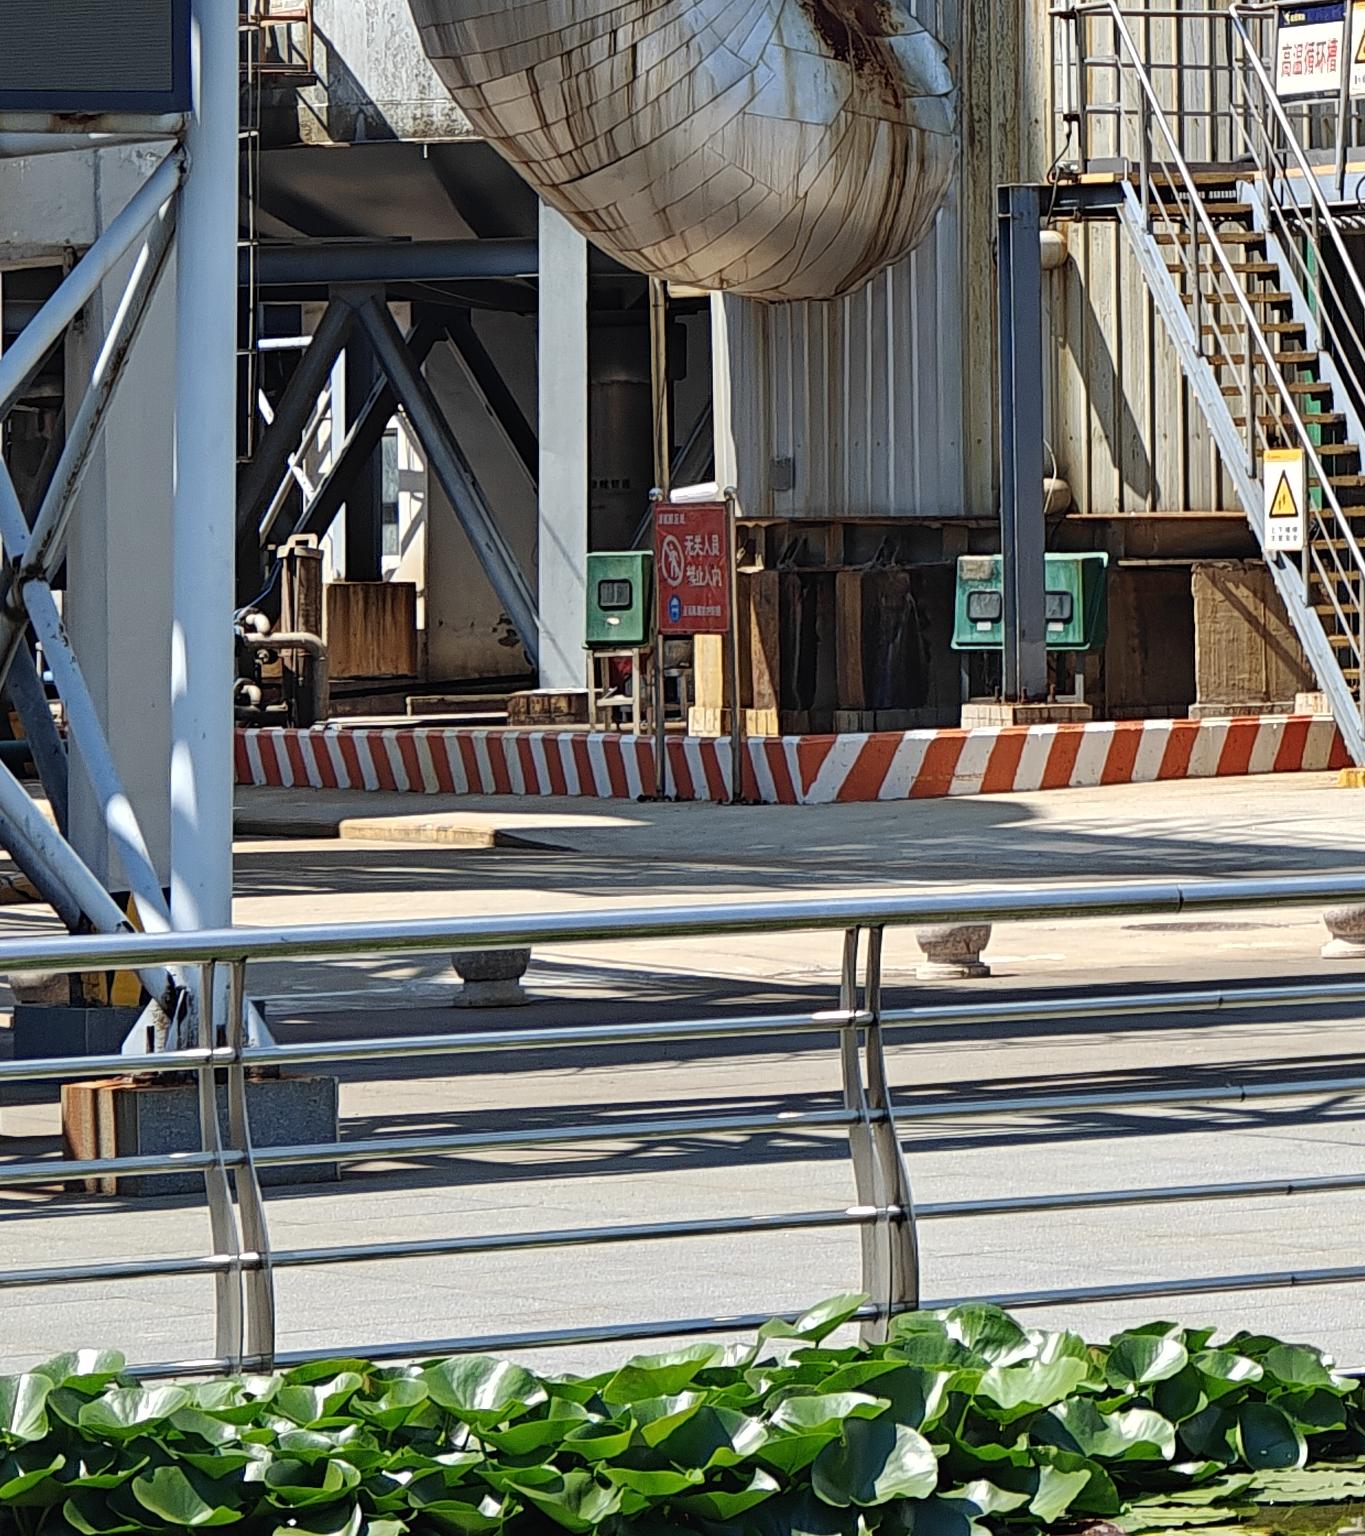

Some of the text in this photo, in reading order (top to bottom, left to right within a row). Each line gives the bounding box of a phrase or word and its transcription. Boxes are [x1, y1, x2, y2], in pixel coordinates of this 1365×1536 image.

[1281, 37, 1338, 77] 高温循环槽
[684, 534, 720, 556] 无关人员
